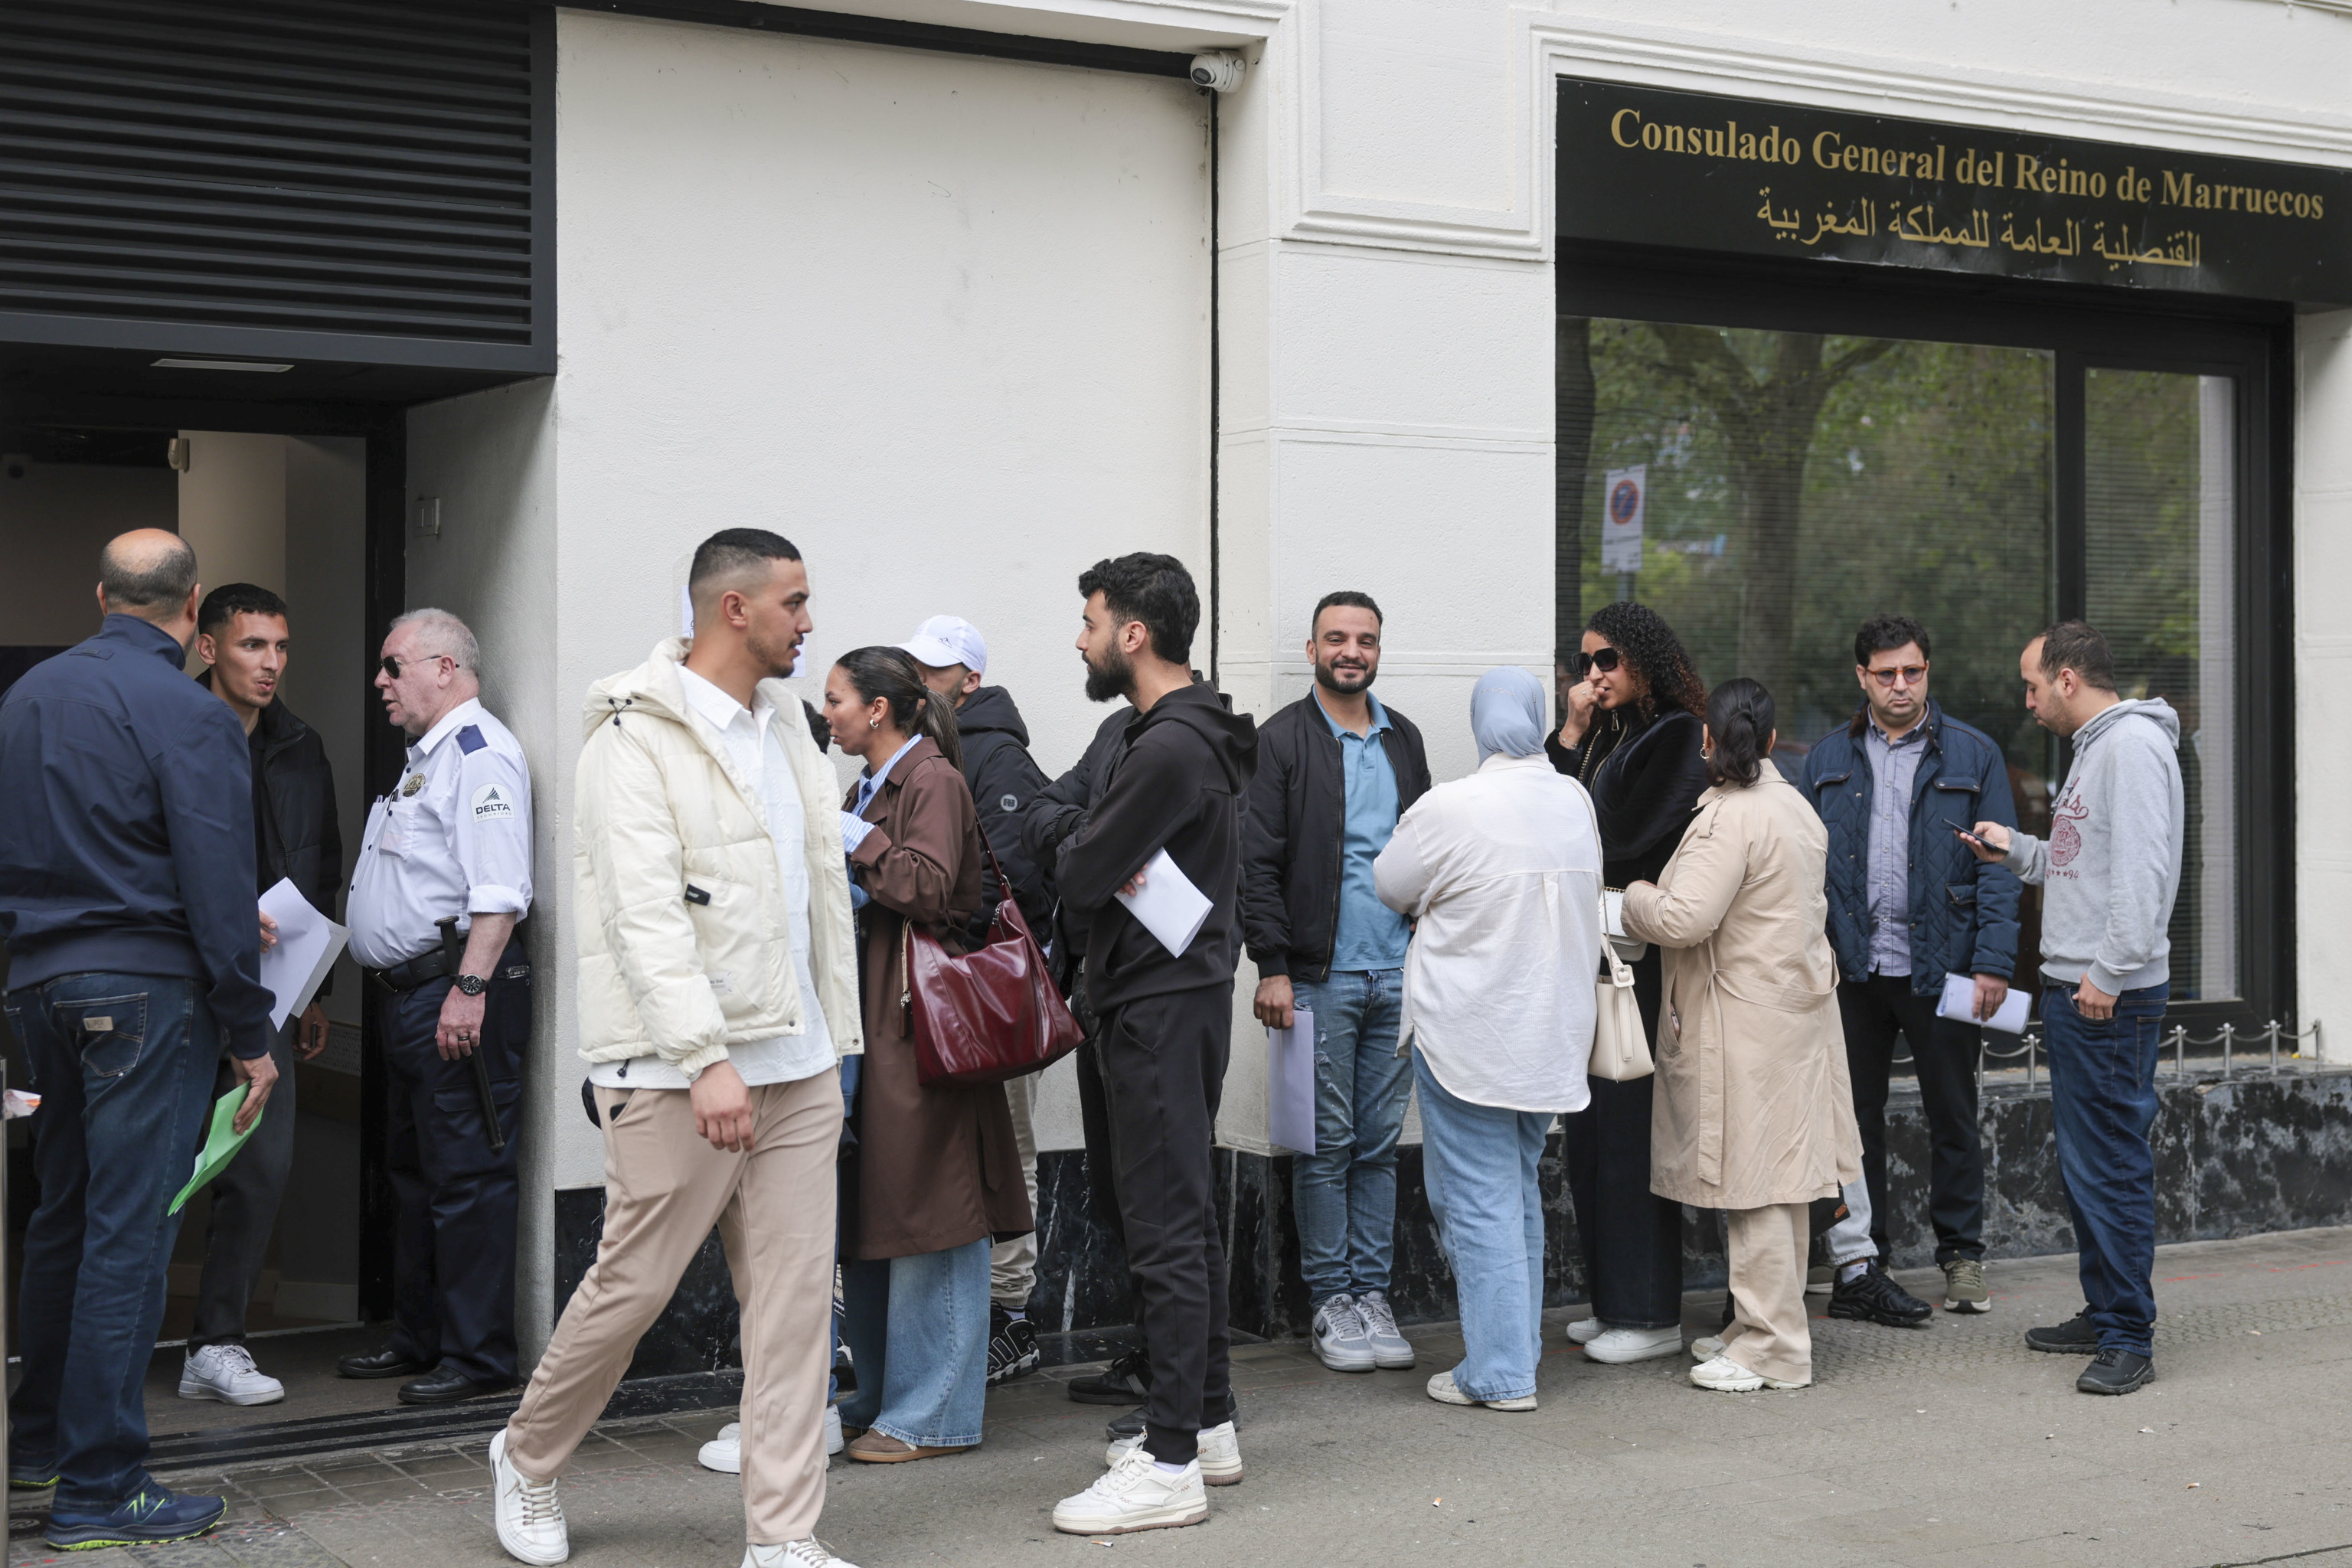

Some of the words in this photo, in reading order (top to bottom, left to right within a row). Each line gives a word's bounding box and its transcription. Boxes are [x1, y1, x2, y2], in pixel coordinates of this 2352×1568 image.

[1610, 109, 1802, 165] Consulado
[1812, 131, 1945, 181] General
[1955, 149, 2004, 188] del
[2015, 154, 2108, 198] Reino
[2116, 166, 2152, 203] de
[2161, 170, 2324, 220] Marruecos
[1756, 187, 1876, 246] المغربية
[1887, 201, 1991, 248] للمملكة
[2000, 212, 2081, 256] العامة
[2092, 221, 2201, 271] القنصلية
[475, 803, 511, 815] DELTA
